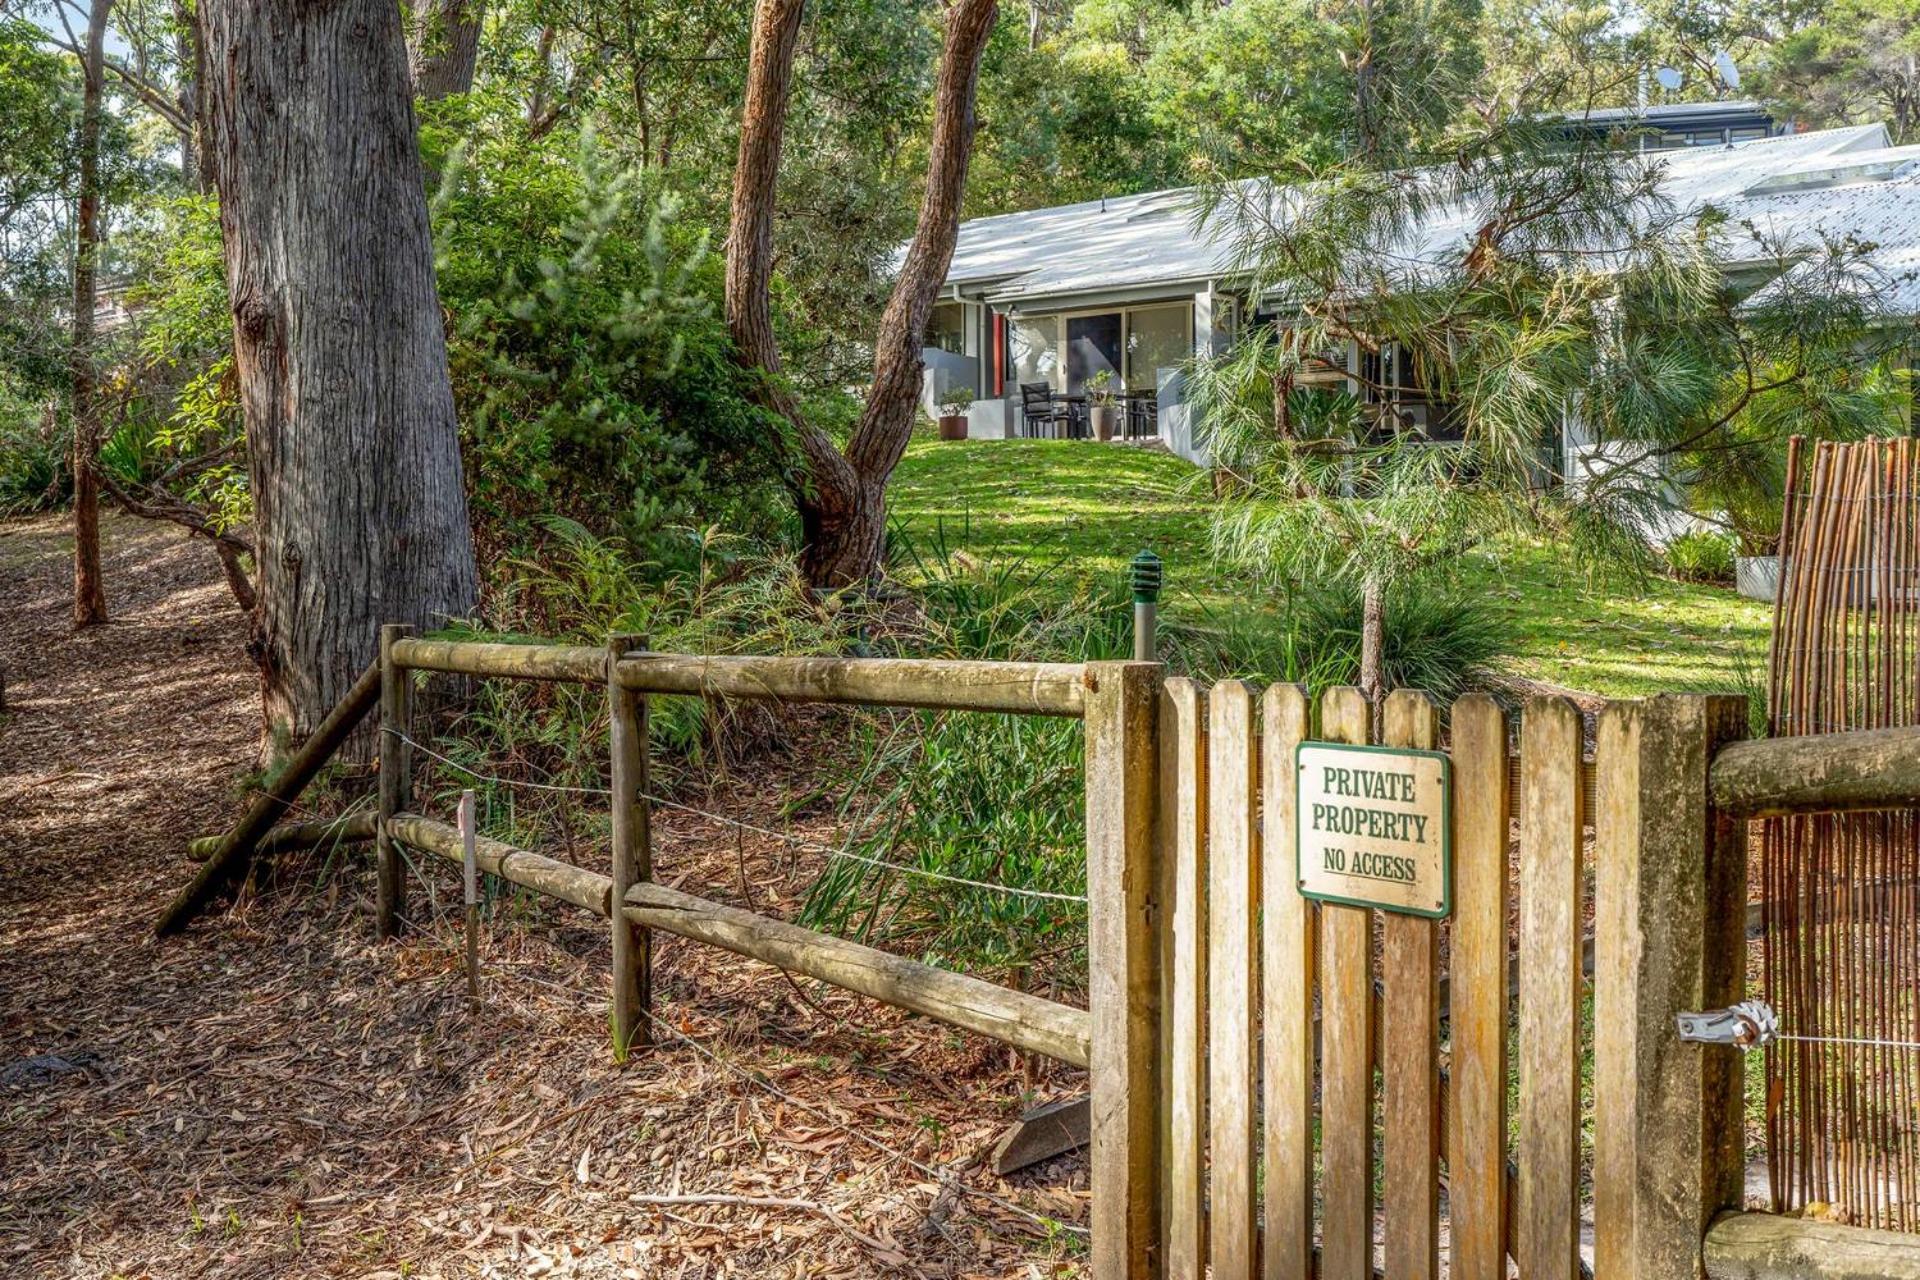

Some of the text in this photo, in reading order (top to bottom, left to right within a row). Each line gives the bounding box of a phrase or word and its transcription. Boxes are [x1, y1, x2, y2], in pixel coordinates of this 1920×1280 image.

[1323, 766, 1416, 803] PRIVATE
[1312, 803, 1428, 844] PROPERTY
[1323, 847, 1416, 882] NO ACCESS
